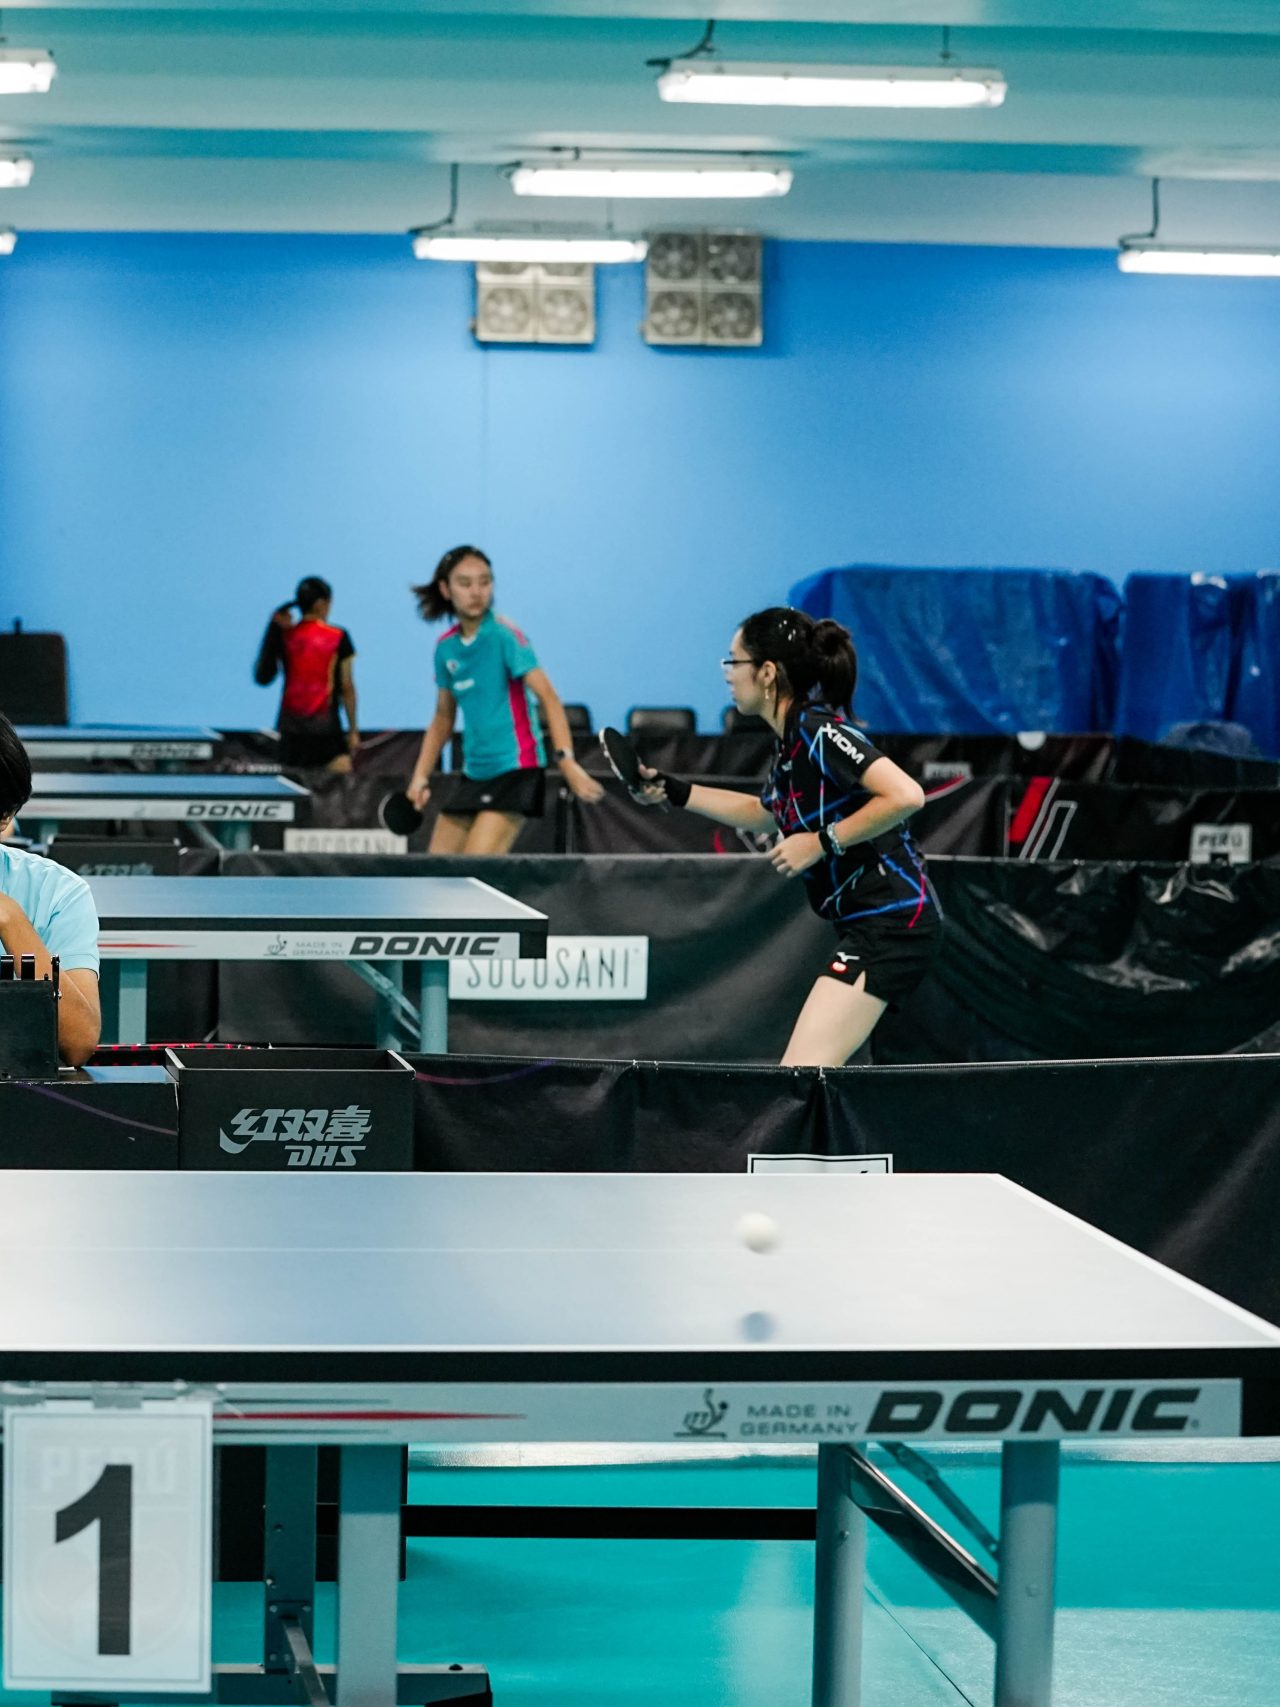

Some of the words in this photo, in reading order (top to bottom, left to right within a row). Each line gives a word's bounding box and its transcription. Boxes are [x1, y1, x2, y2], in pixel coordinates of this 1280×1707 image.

[821, 722, 866, 764] XIOM
[186, 803, 281, 818] DONIC
[349, 936, 501, 956] DONIC
[220, 1105, 372, 1154] 红双喜
[284, 1145, 367, 1166] DHS
[746, 1404, 816, 1418] MADE
[826, 1404, 850, 1417] IN
[865, 1387, 1202, 1434] DONIC
[739, 1421, 860, 1436] GERMANY
[55, 1464, 133, 1655] 1
